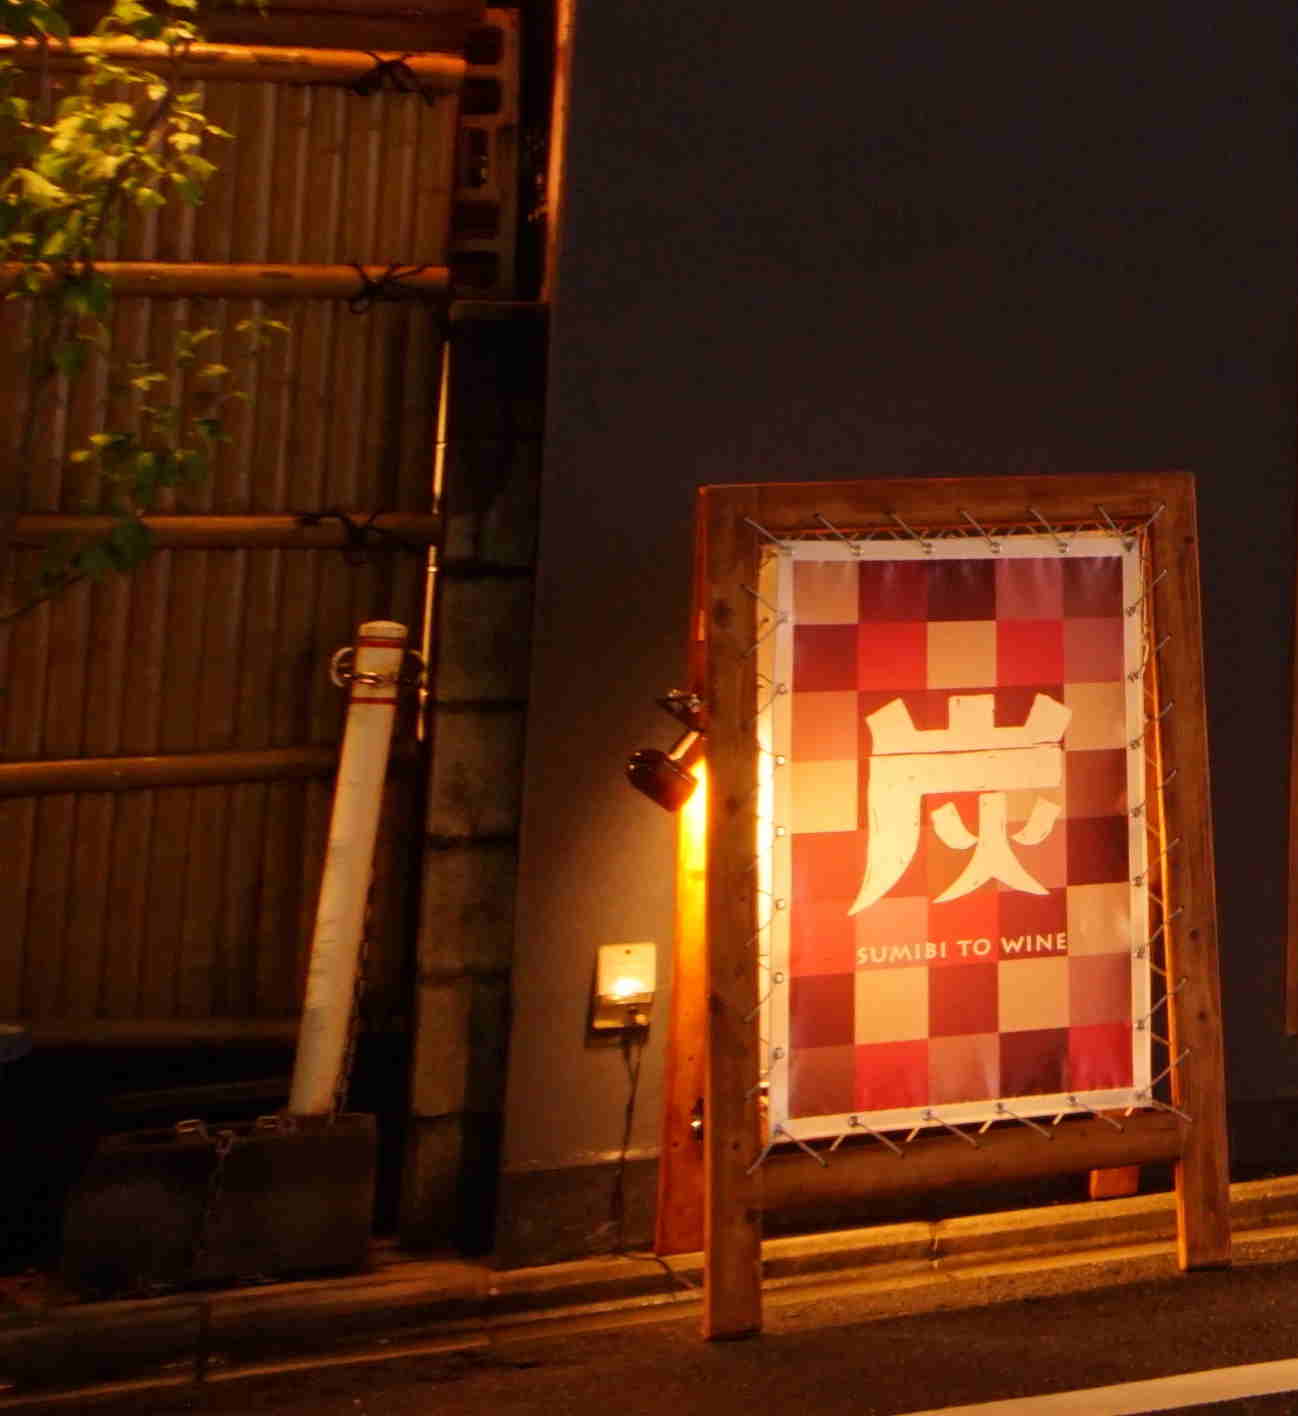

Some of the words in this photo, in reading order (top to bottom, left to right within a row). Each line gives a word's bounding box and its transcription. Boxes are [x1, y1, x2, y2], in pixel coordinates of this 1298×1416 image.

[848, 693, 1072, 916] 炭
[856, 941, 948, 964] SUMIBI
[956, 938, 991, 957] TO
[1001, 931, 1067, 953] WINE
